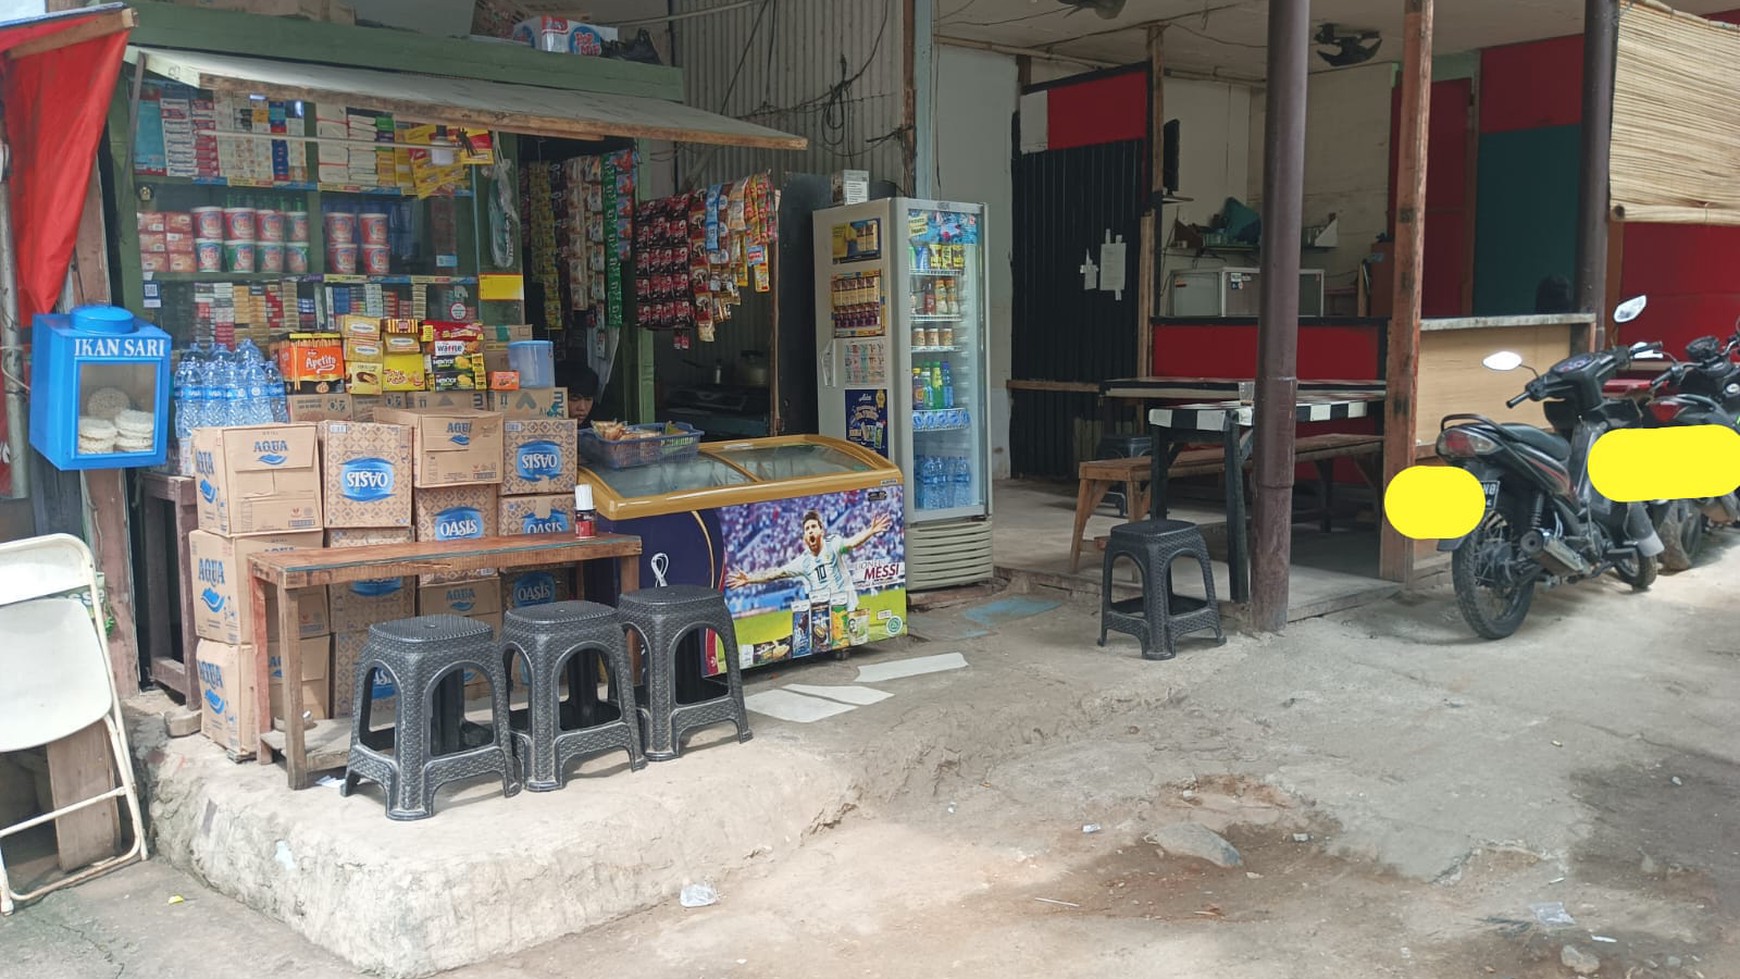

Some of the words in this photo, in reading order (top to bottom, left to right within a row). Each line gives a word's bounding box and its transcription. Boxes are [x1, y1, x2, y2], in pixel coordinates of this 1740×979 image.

[74, 339, 118, 356] IKAN
[124, 339, 165, 356] SARI
[254, 440, 288, 453] AQUA
[522, 453, 557, 469] OASIS
[347, 471, 388, 487] OASIS
[440, 520, 477, 536] OASIS
[199, 558, 225, 588] AQUA
[815, 564, 827, 581] 10
[864, 564, 899, 580] MESSI
[518, 584, 550, 601] OASIS
